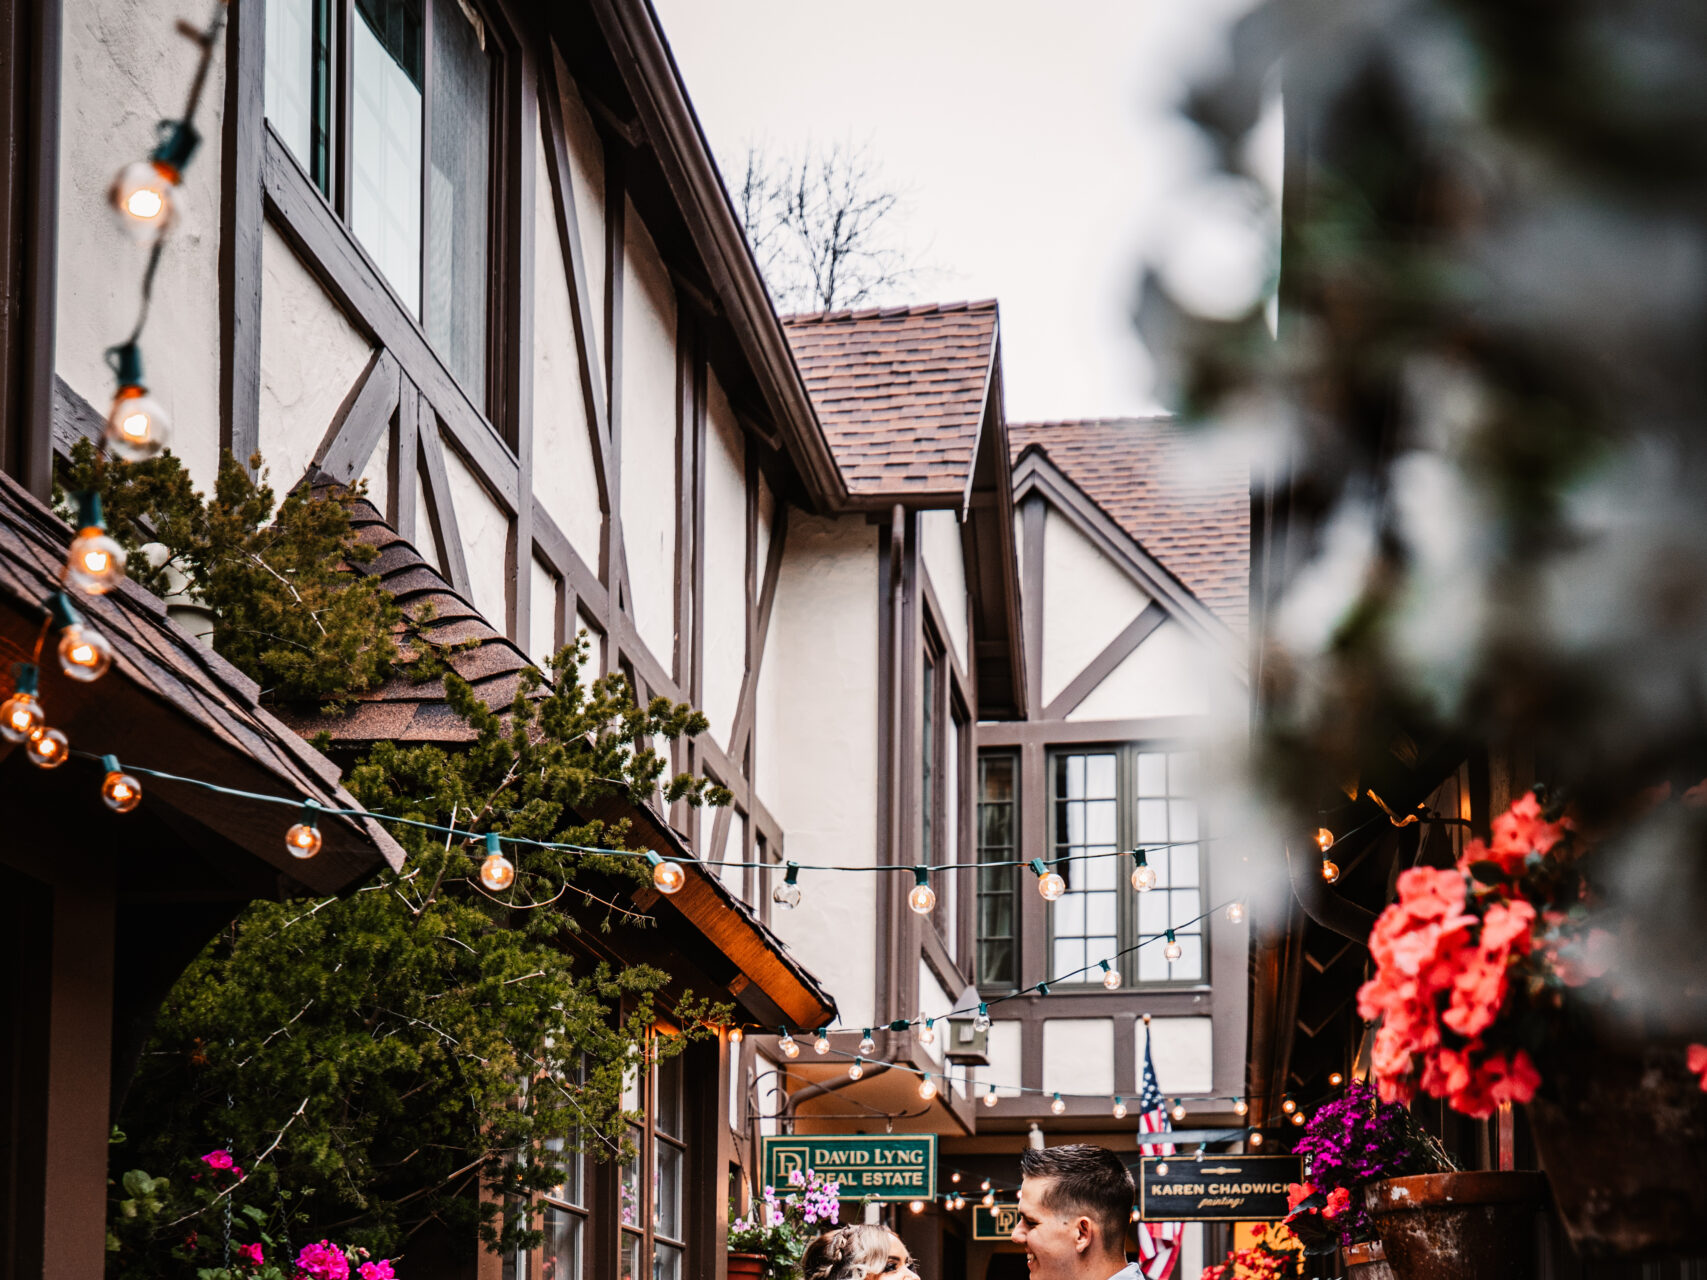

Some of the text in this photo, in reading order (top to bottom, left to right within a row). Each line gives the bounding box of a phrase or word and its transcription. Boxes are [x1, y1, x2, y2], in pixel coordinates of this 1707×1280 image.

[814, 1148, 924, 1165] DAVID LYNG
[815, 1172, 923, 1186] REAL ESTATE
[1151, 1184, 1205, 1196] KAREN
